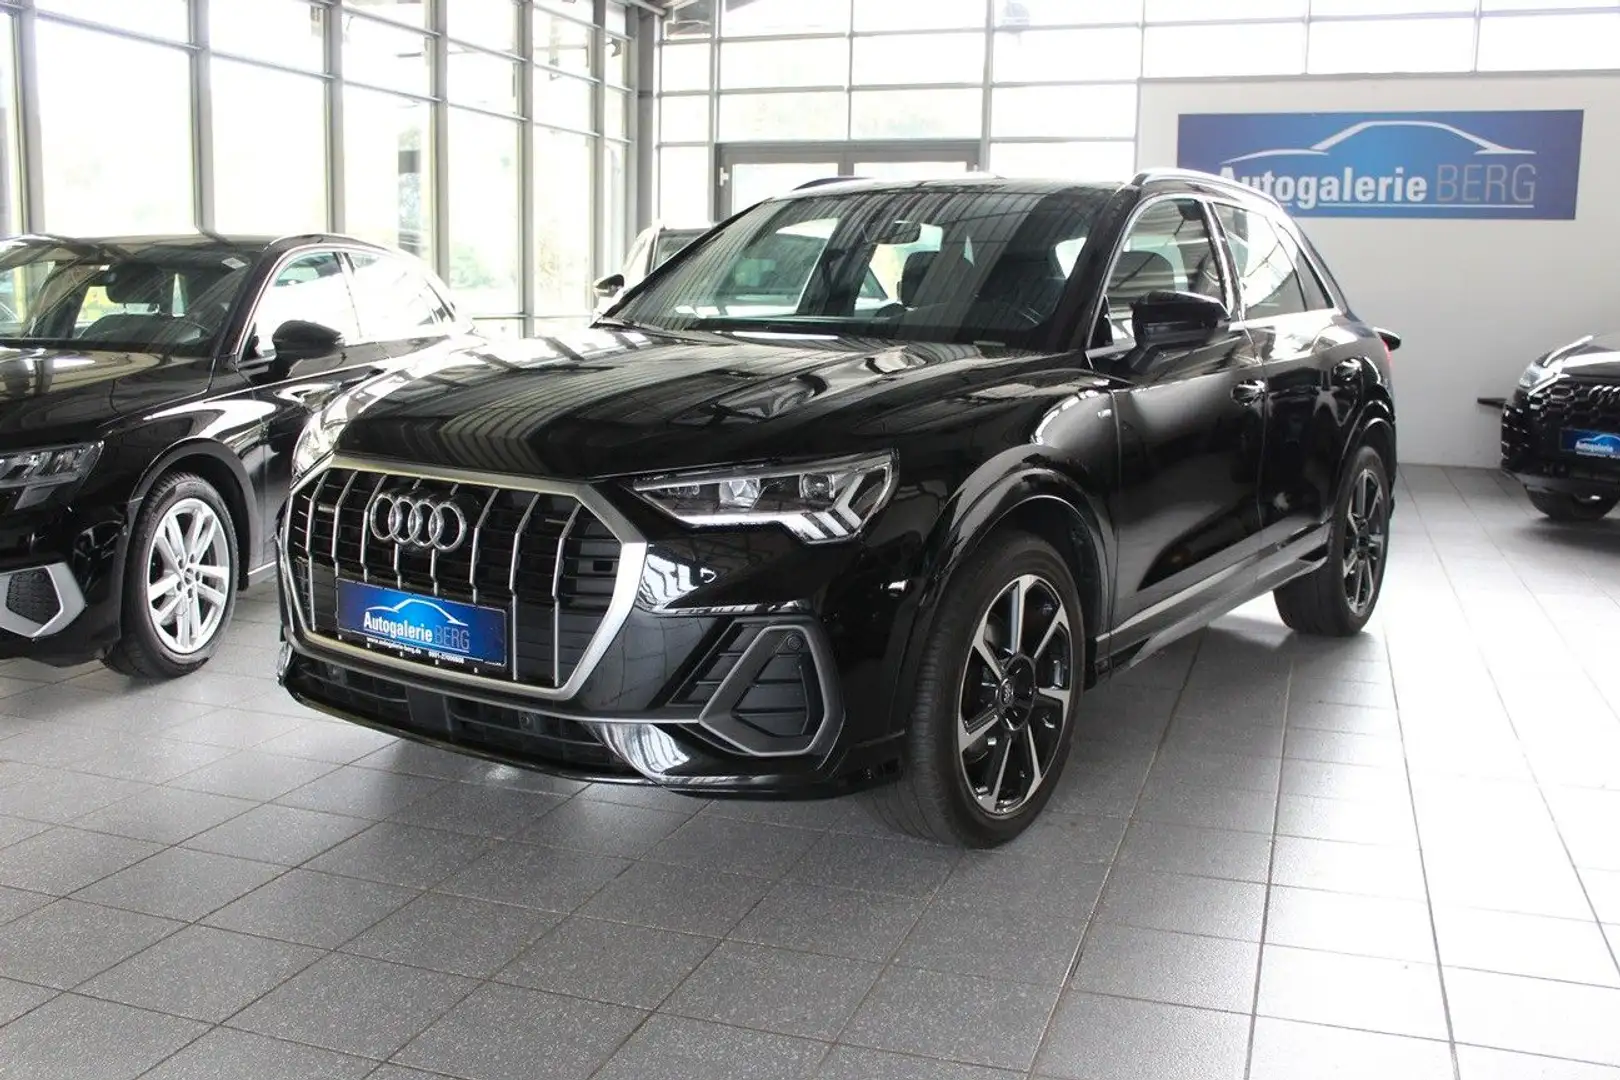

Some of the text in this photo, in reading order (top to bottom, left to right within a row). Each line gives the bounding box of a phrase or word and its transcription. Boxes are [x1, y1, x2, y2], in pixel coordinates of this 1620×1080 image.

[1436, 163, 1537, 202] BERG
[363, 611, 470, 650] Autogalerie BERG
